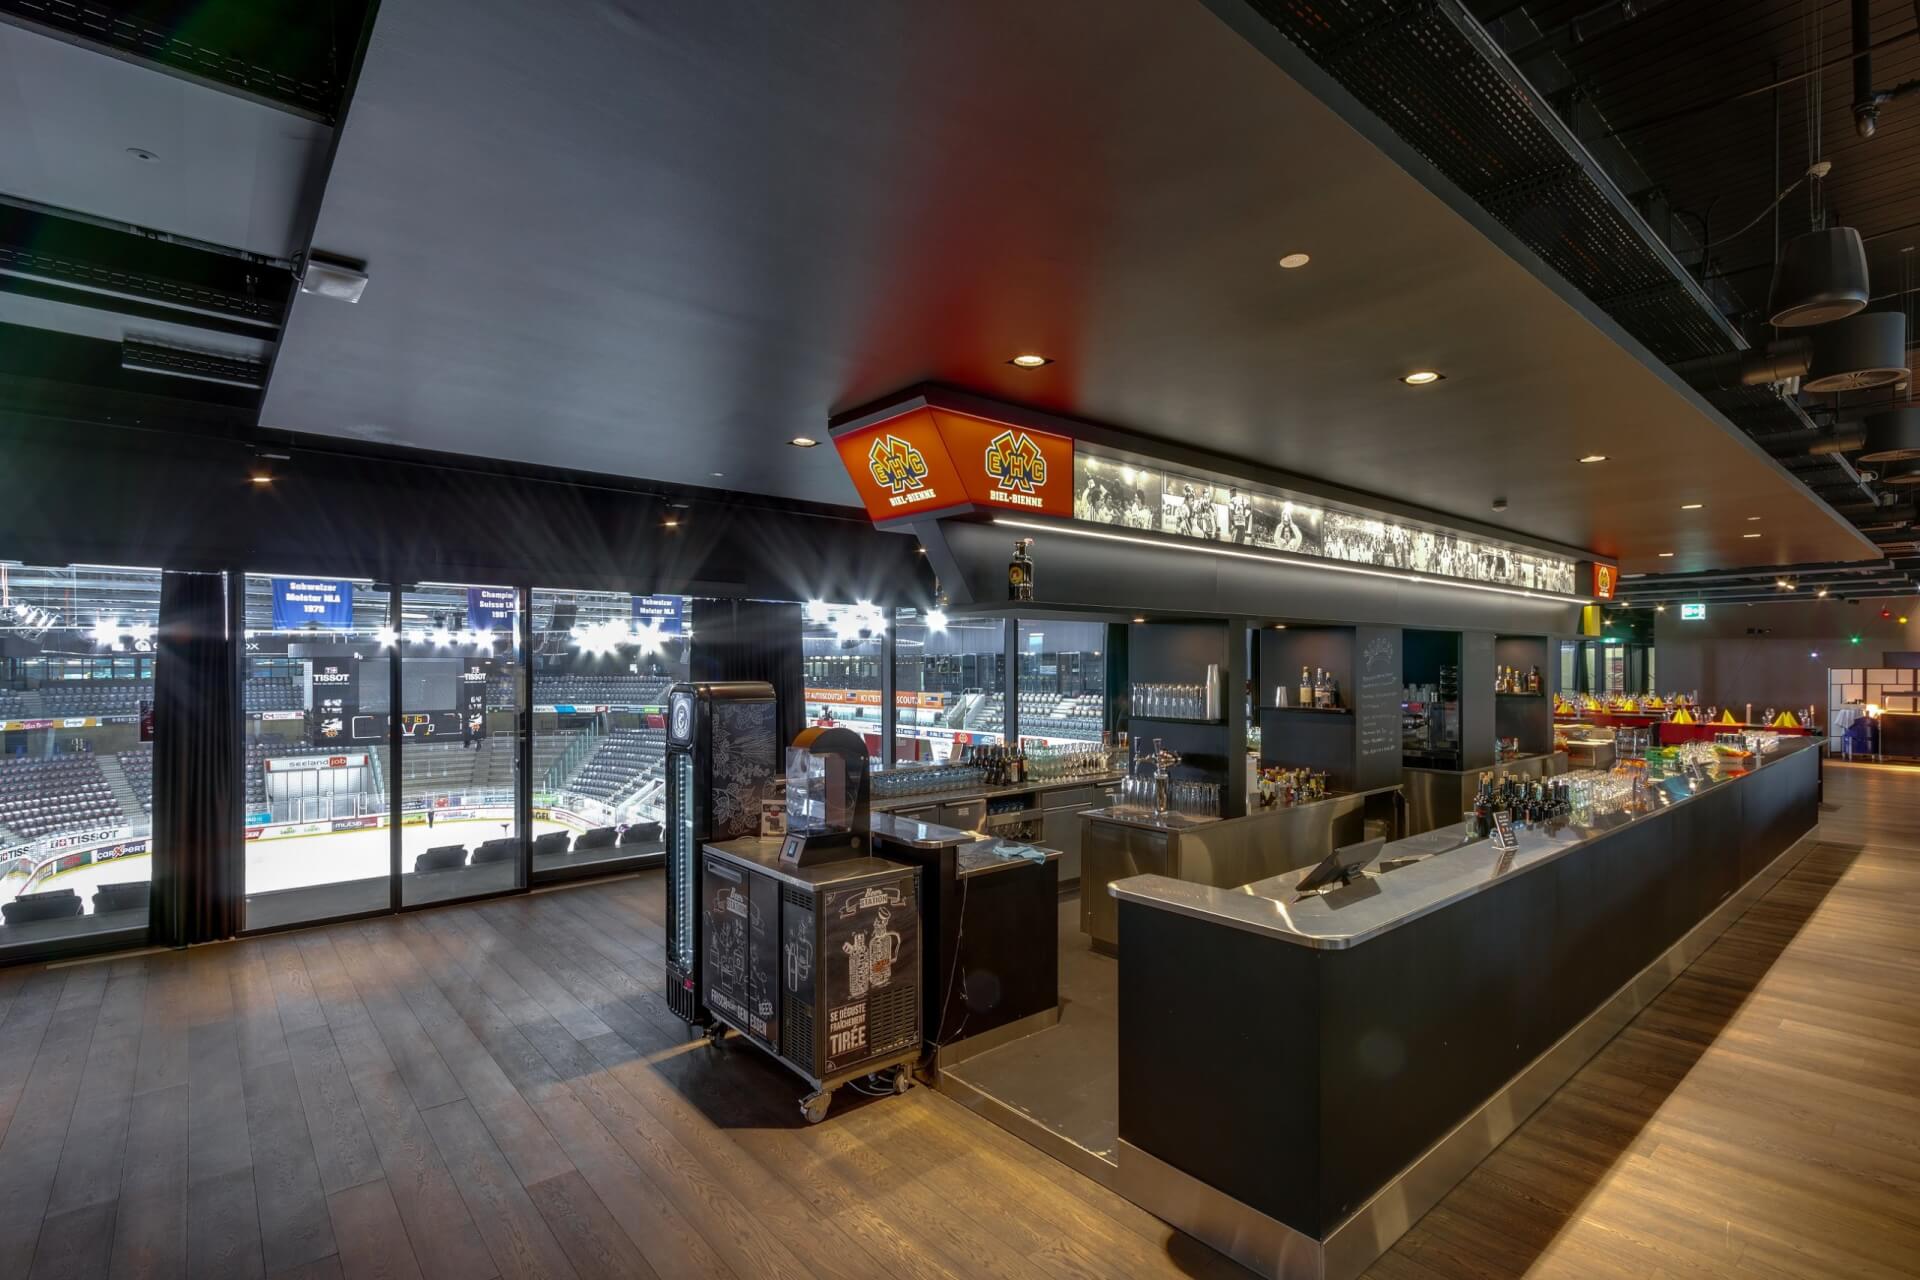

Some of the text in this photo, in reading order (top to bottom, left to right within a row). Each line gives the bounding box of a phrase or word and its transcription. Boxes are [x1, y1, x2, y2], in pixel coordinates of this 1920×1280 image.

[873, 453, 925, 484] EHC
[988, 450, 1044, 484] EHC
[889, 488, 937, 507] BIEL-BIENNE
[990, 490, 1043, 508] BIEL-BIENNE
[289, 582, 337, 592] Schweizer
[285, 592, 341, 603] Meister NLA
[481, 591, 513, 600] Champio
[480, 600, 504, 608] Suisse
[642, 598, 672, 606] Schweizer
[313, 674, 350, 682] TISSOT
[464, 673, 487, 681] TISSOT
[289, 757, 347, 768] seeland job
[70, 830, 119, 845] TISSOT
[860, 895, 888, 907] STATION
[830, 1003, 867, 1022] SE DÉGUSTE
[829, 1025, 867, 1055] TIRÉE
